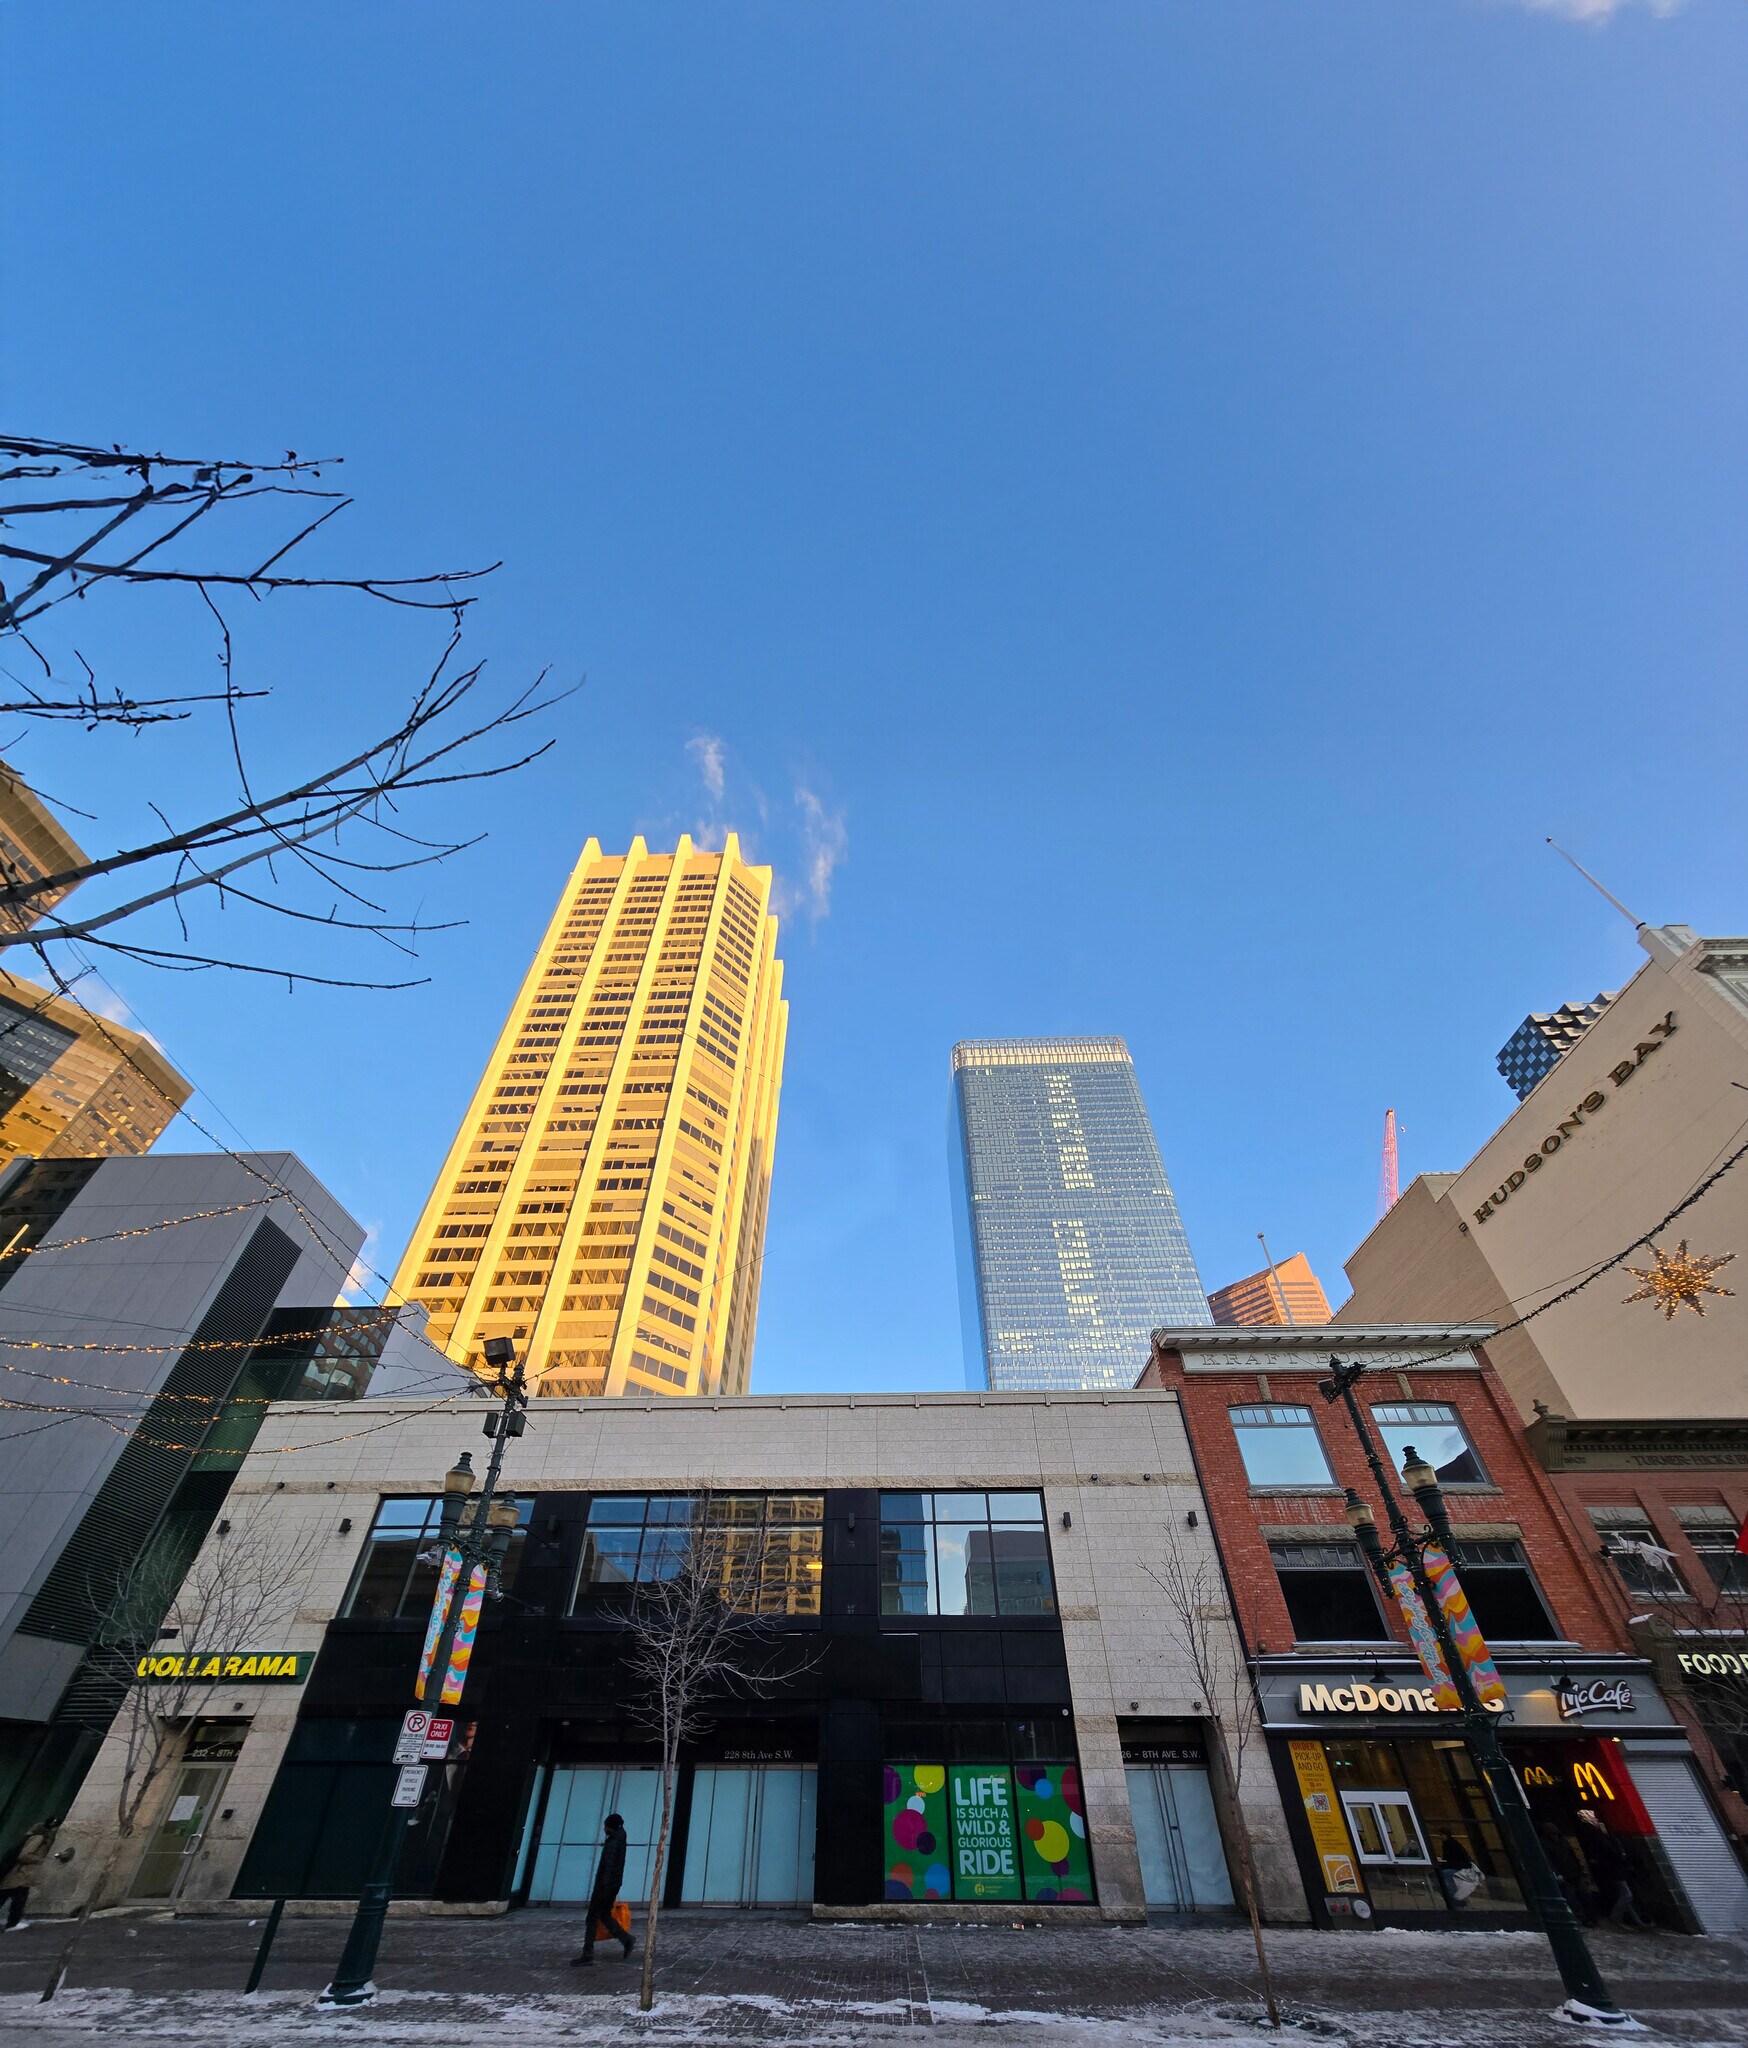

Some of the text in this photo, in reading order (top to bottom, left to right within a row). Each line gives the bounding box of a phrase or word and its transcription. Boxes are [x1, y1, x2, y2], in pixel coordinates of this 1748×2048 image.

[1472, 1011, 1677, 1225] HUDSON'S BAY
[1200, 1351, 1298, 1366] KRAFT
[136, 1655, 297, 1677] DOLLARAMA
[1561, 1680, 1631, 1713] McCafé
[192, 1749, 208, 1757] 232
[216, 1749, 234, 1757] 8TH
[724, 1750, 794, 1759] 228 8th Ave S.W.
[1142, 1750, 1159, 1758] 8TH
[1162, 1750, 1180, 1758] AVE.
[1182, 1750, 1201, 1758] S.W.
[1294, 1752, 1322, 1761] PICK-UP
[1298, 1762, 1325, 1771] AND GO.
[954, 1777, 1008, 1806] LIFE
[956, 1808, 1009, 1819] IS SUCH A
[957, 1820, 1011, 1836] WILD &
[958, 1837, 1012, 1849] GLORIOUS
[959, 1849, 1015, 1876] RIDE
